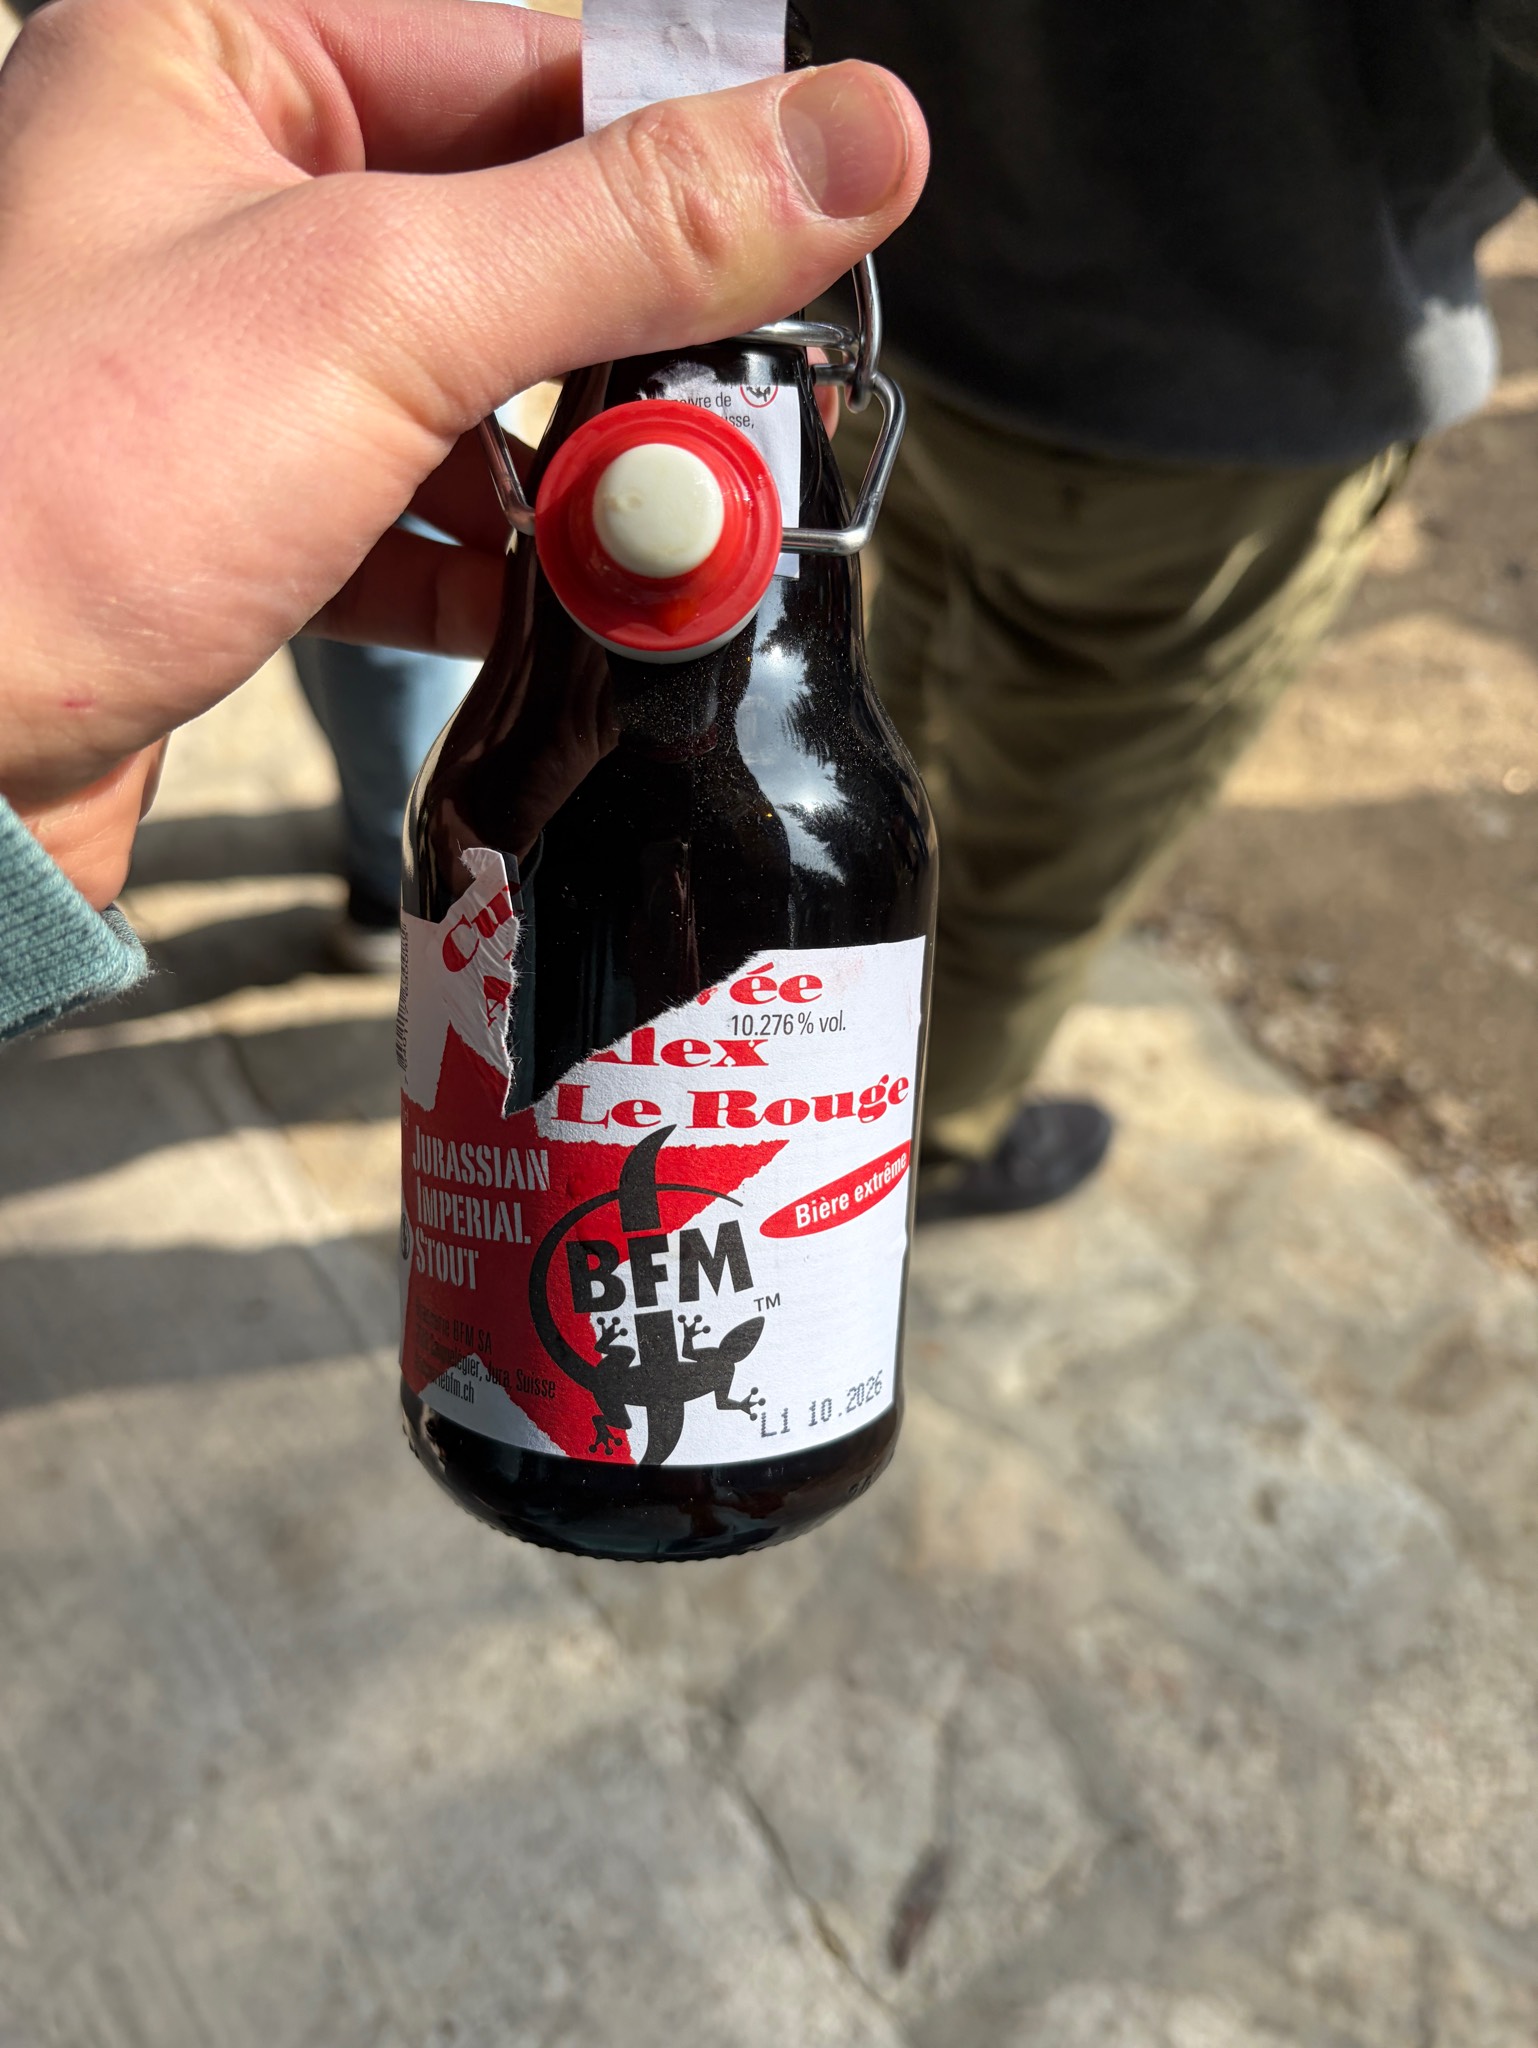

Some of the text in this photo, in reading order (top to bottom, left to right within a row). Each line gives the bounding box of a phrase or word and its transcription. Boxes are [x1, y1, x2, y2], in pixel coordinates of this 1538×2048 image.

[715, 391, 732, 407] de
[697, 961, 823, 1006] ée
[731, 1013, 794, 1037] 10.276
[819, 1009, 847, 1033] vol.
[551, 1073, 910, 1130] Le Rouge
[412, 1126, 551, 1192] JURASSIAN
[417, 1178, 532, 1245] IMPERIAL
[794, 1151, 909, 1230] Bière extrême
[415, 1228, 479, 1290] STOUT
[565, 1219, 782, 1314] BFM TM
[477, 1329, 493, 1355] SA
[516, 1368, 558, 1399] Suisse
[760, 1368, 884, 1438] L1 10.2026
